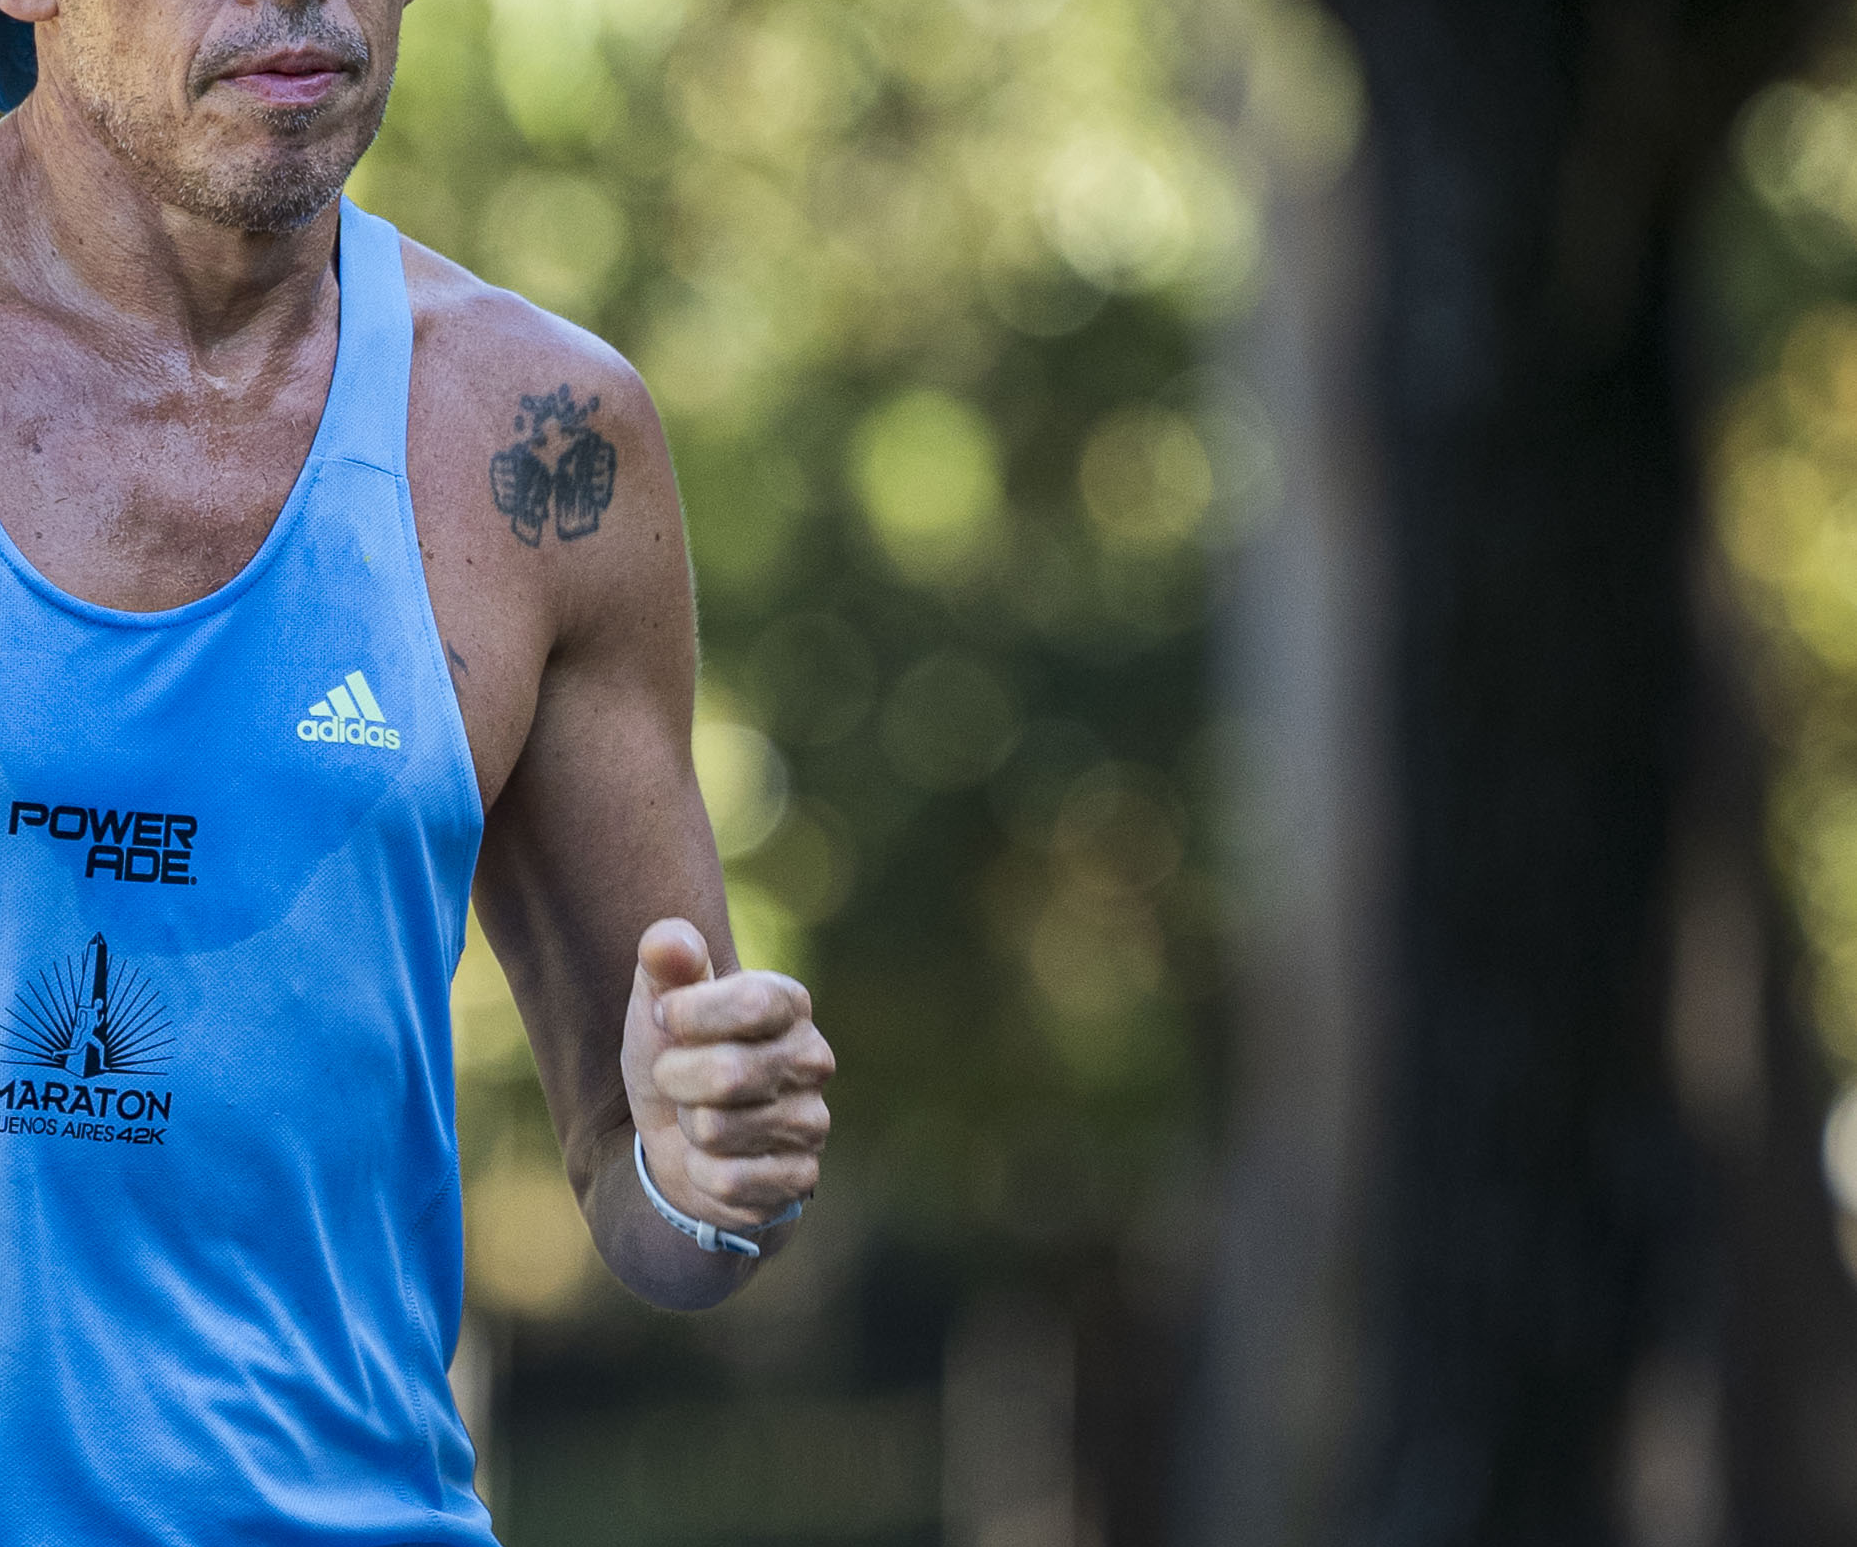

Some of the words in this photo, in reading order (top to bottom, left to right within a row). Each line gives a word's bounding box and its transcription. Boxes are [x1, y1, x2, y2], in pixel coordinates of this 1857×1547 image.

[296, 715, 401, 750] adidas
[8, 801, 198, 850] POWER
[61, 1121, 115, 1143] AIRES
[116, 1127, 167, 1145] 42K
